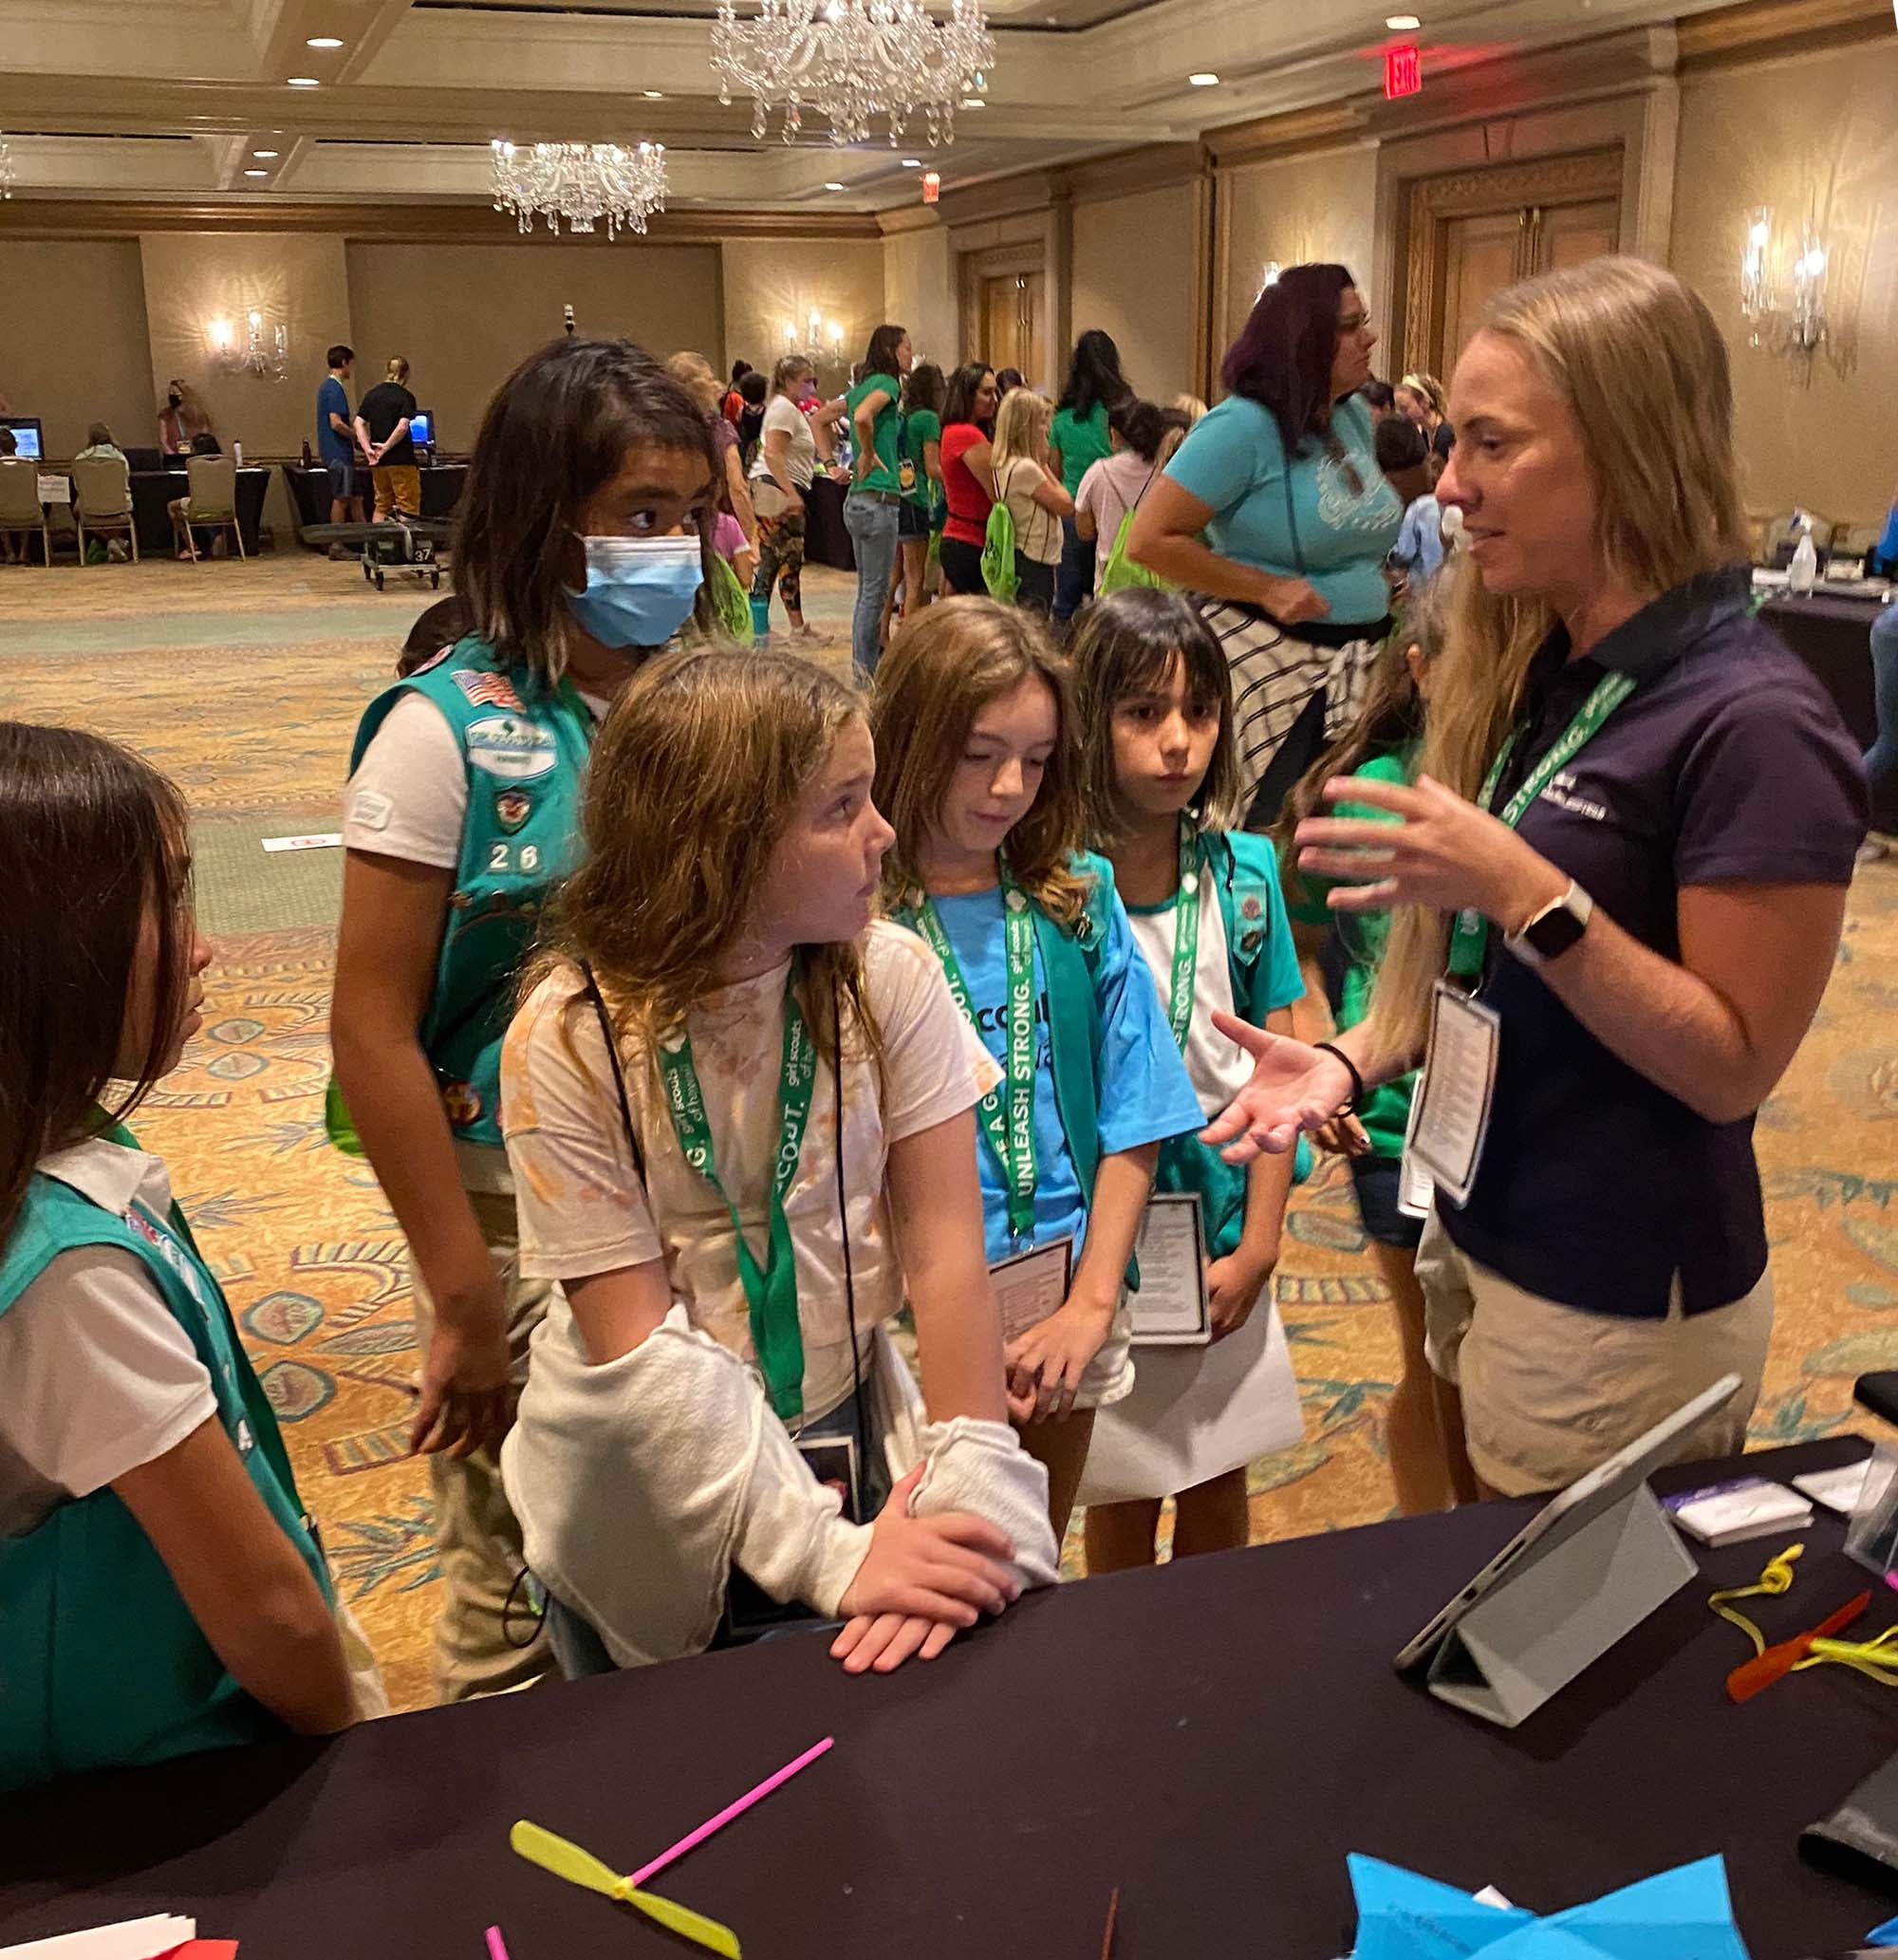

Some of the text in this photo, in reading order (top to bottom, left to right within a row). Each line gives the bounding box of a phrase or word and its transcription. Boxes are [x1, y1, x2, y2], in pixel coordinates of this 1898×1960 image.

[415, 549, 431, 561] 37
[1014, 978, 1034, 1197] UNLEASH STRONG.
